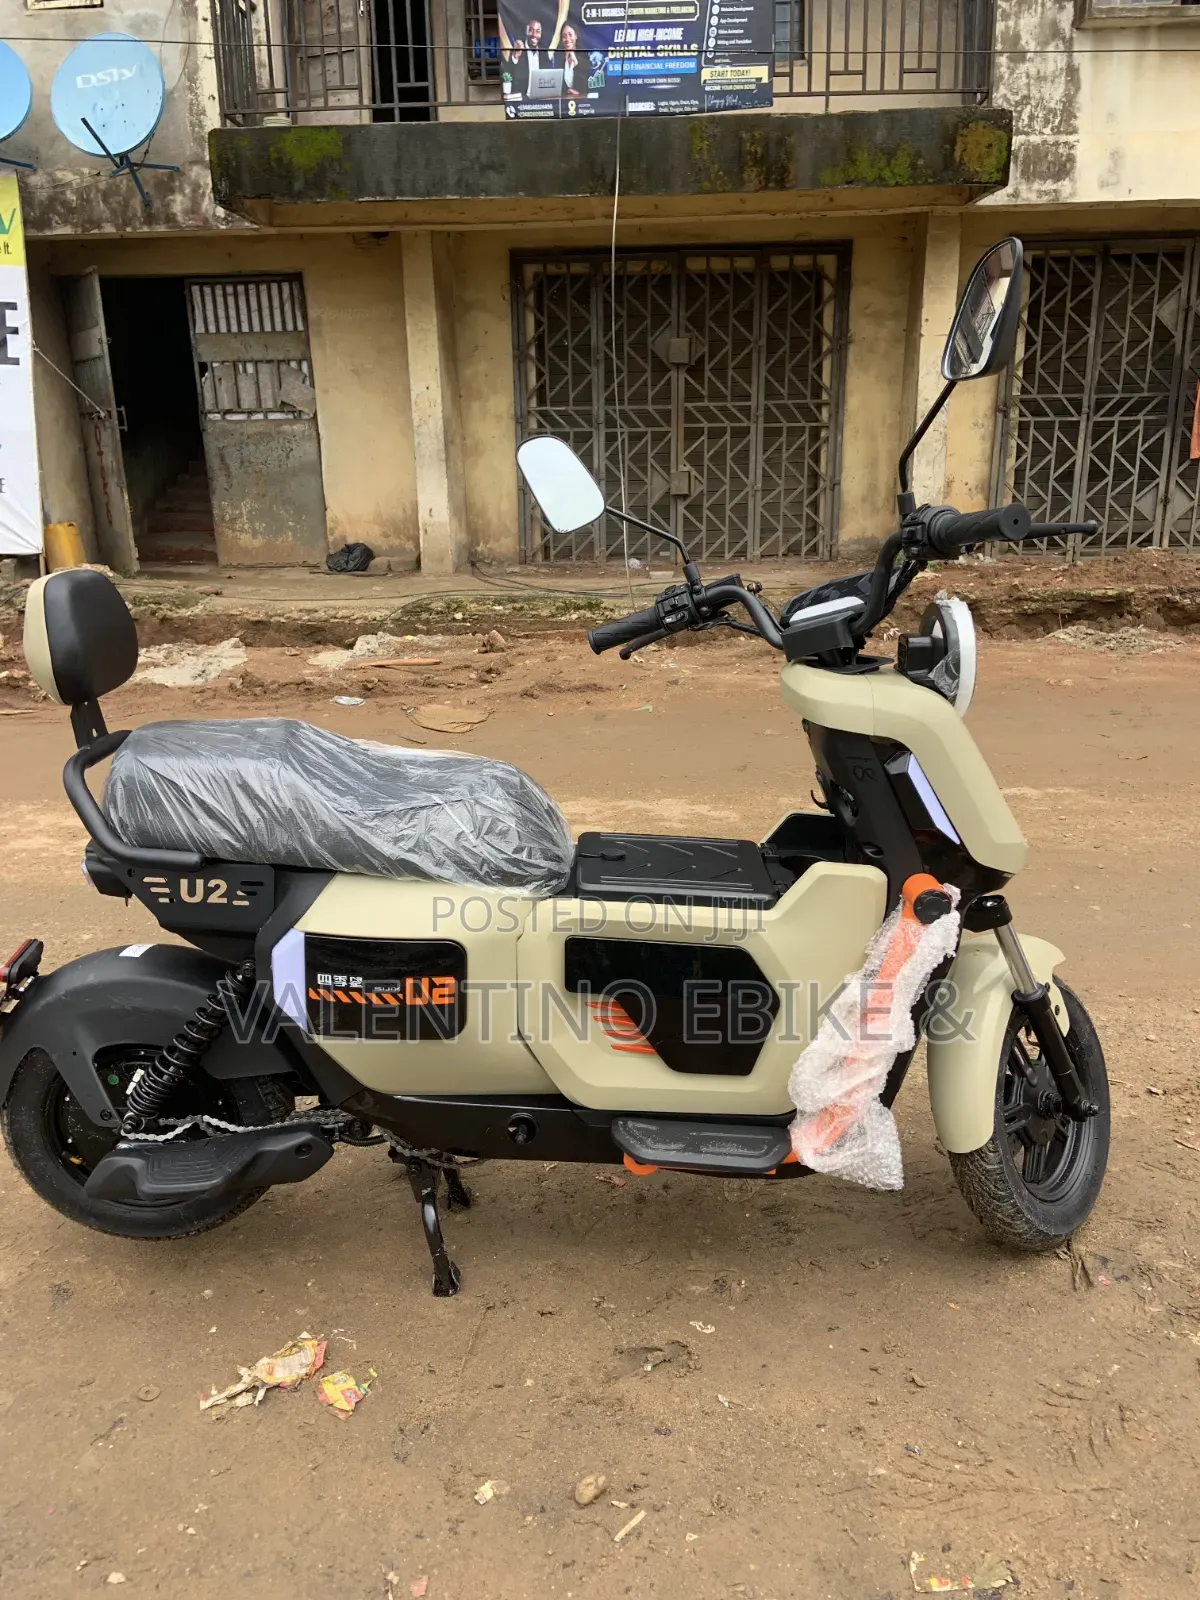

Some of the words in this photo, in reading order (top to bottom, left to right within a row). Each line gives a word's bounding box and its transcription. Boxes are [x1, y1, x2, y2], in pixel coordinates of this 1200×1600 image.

[637, 28, 684, 41] HIGH-INCOME
[656, 43, 699, 57] SKILLS
[631, 62, 664, 70] FINANCIAL
[665, 61, 696, 69] FREEDOM
[180, 878, 228, 904] U2
[405, 976, 456, 1006] U2
